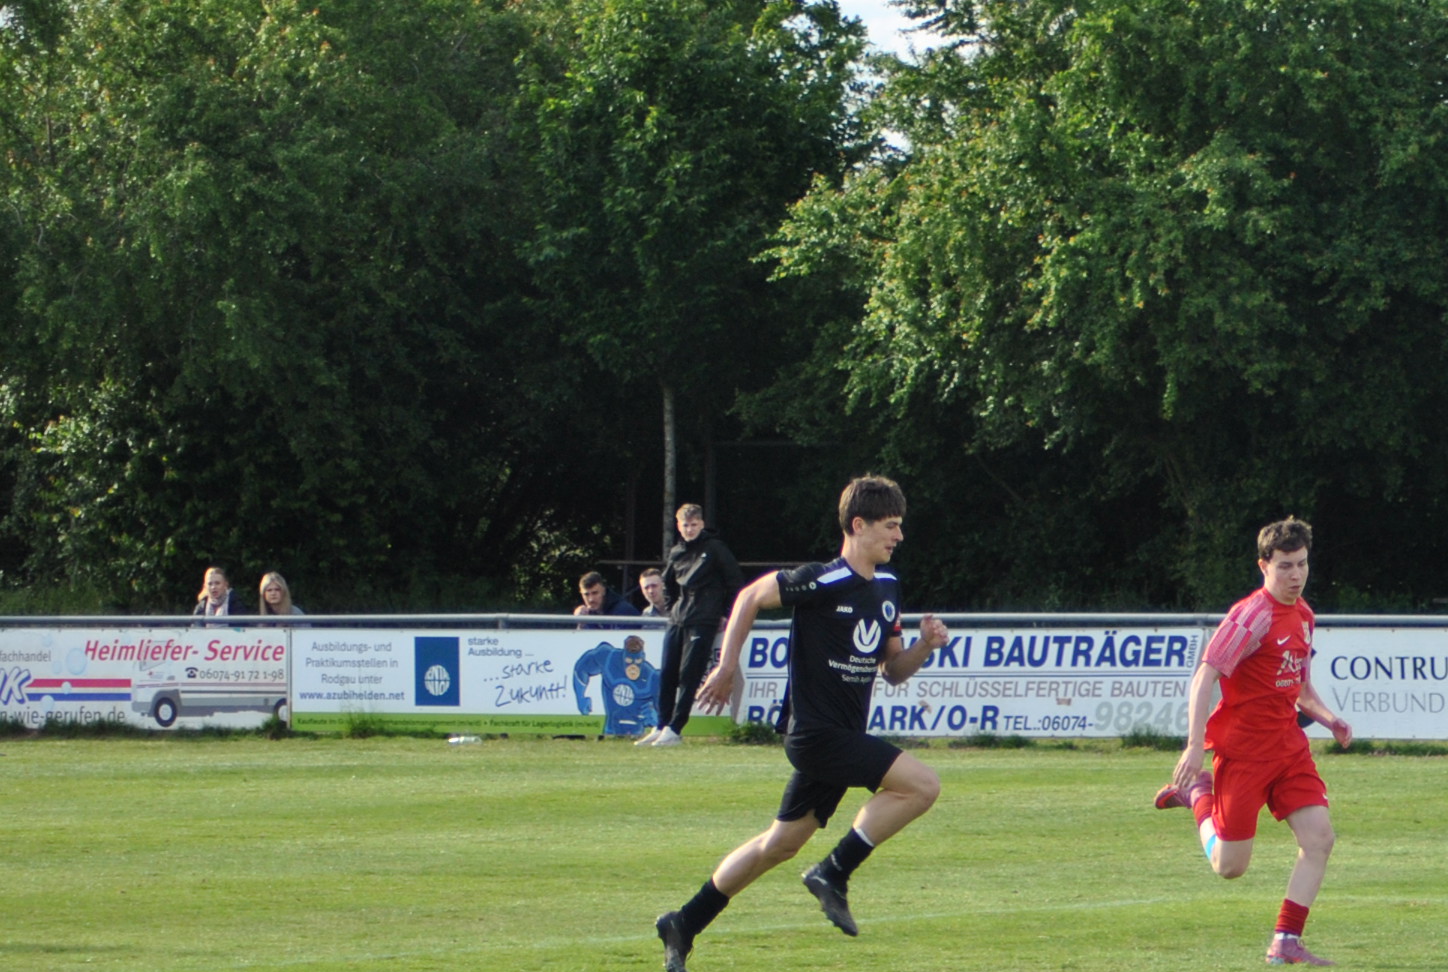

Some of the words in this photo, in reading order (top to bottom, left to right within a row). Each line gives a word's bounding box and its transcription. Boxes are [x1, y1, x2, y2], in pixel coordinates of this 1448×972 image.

[836, 605, 853, 614] JAKO
[311, 641, 372, 654] Ausbildungs-
[374, 642, 392, 652] und
[468, 637, 499, 646] starke
[85, 639, 199, 661] Heimliefer-
[204, 639, 285, 661] Service
[468, 647, 522, 659] Ausbildung
[983, 630, 1188, 668] BAUTRÄGER
[305, 657, 389, 669] Praktikumsstellen
[390, 658, 399, 668] in
[321, 673, 356, 686] Rodgau
[358, 675, 383, 684] unter
[748, 681, 778, 699] IHR
[916, 677, 1104, 699] SCHLÜSSELFERTIGE
[1110, 680, 1187, 698] BAUTEN
